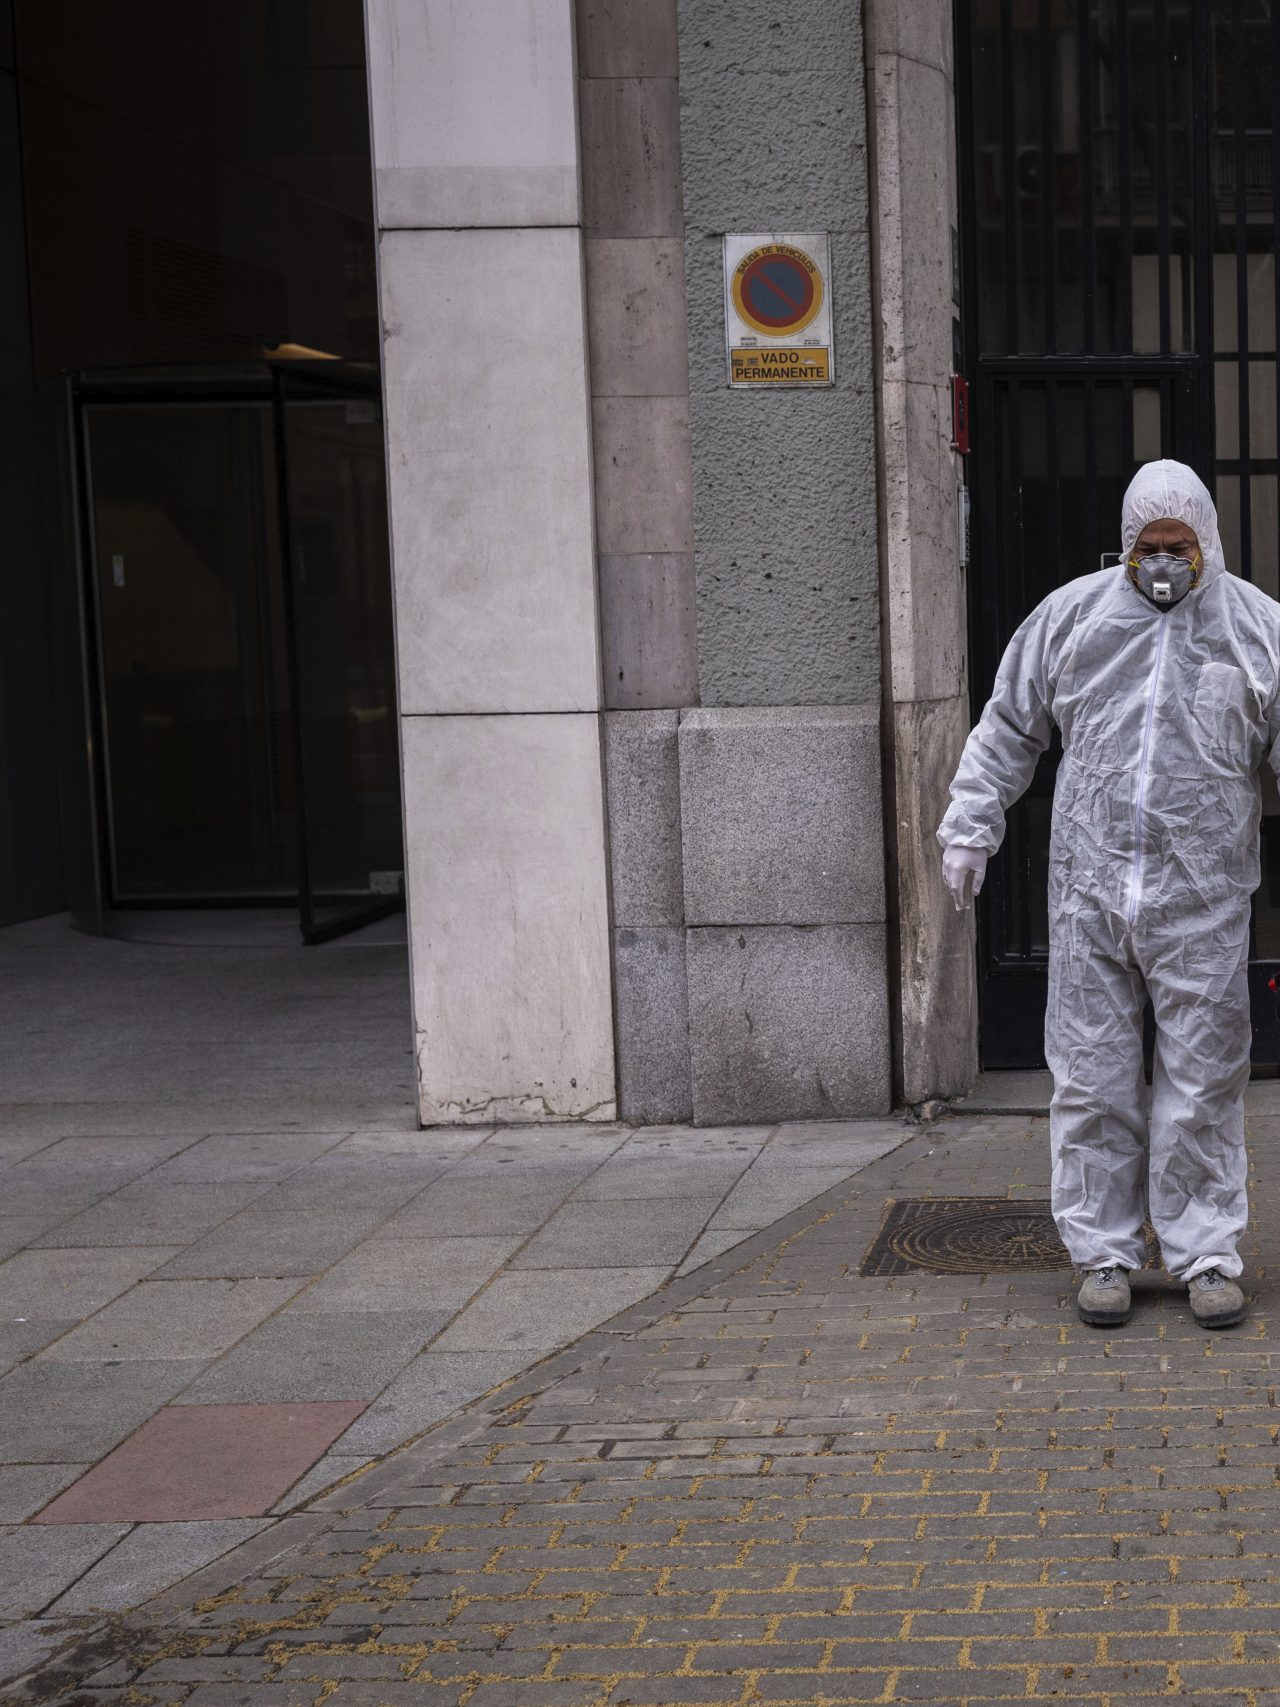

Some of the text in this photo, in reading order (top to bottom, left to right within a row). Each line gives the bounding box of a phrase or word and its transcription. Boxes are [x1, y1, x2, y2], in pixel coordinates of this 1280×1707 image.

[737, 246, 816, 275] SALIDA DE VEHICULOS
[760, 352, 799, 364] VADO
[736, 366, 825, 379] PERMANENTE
